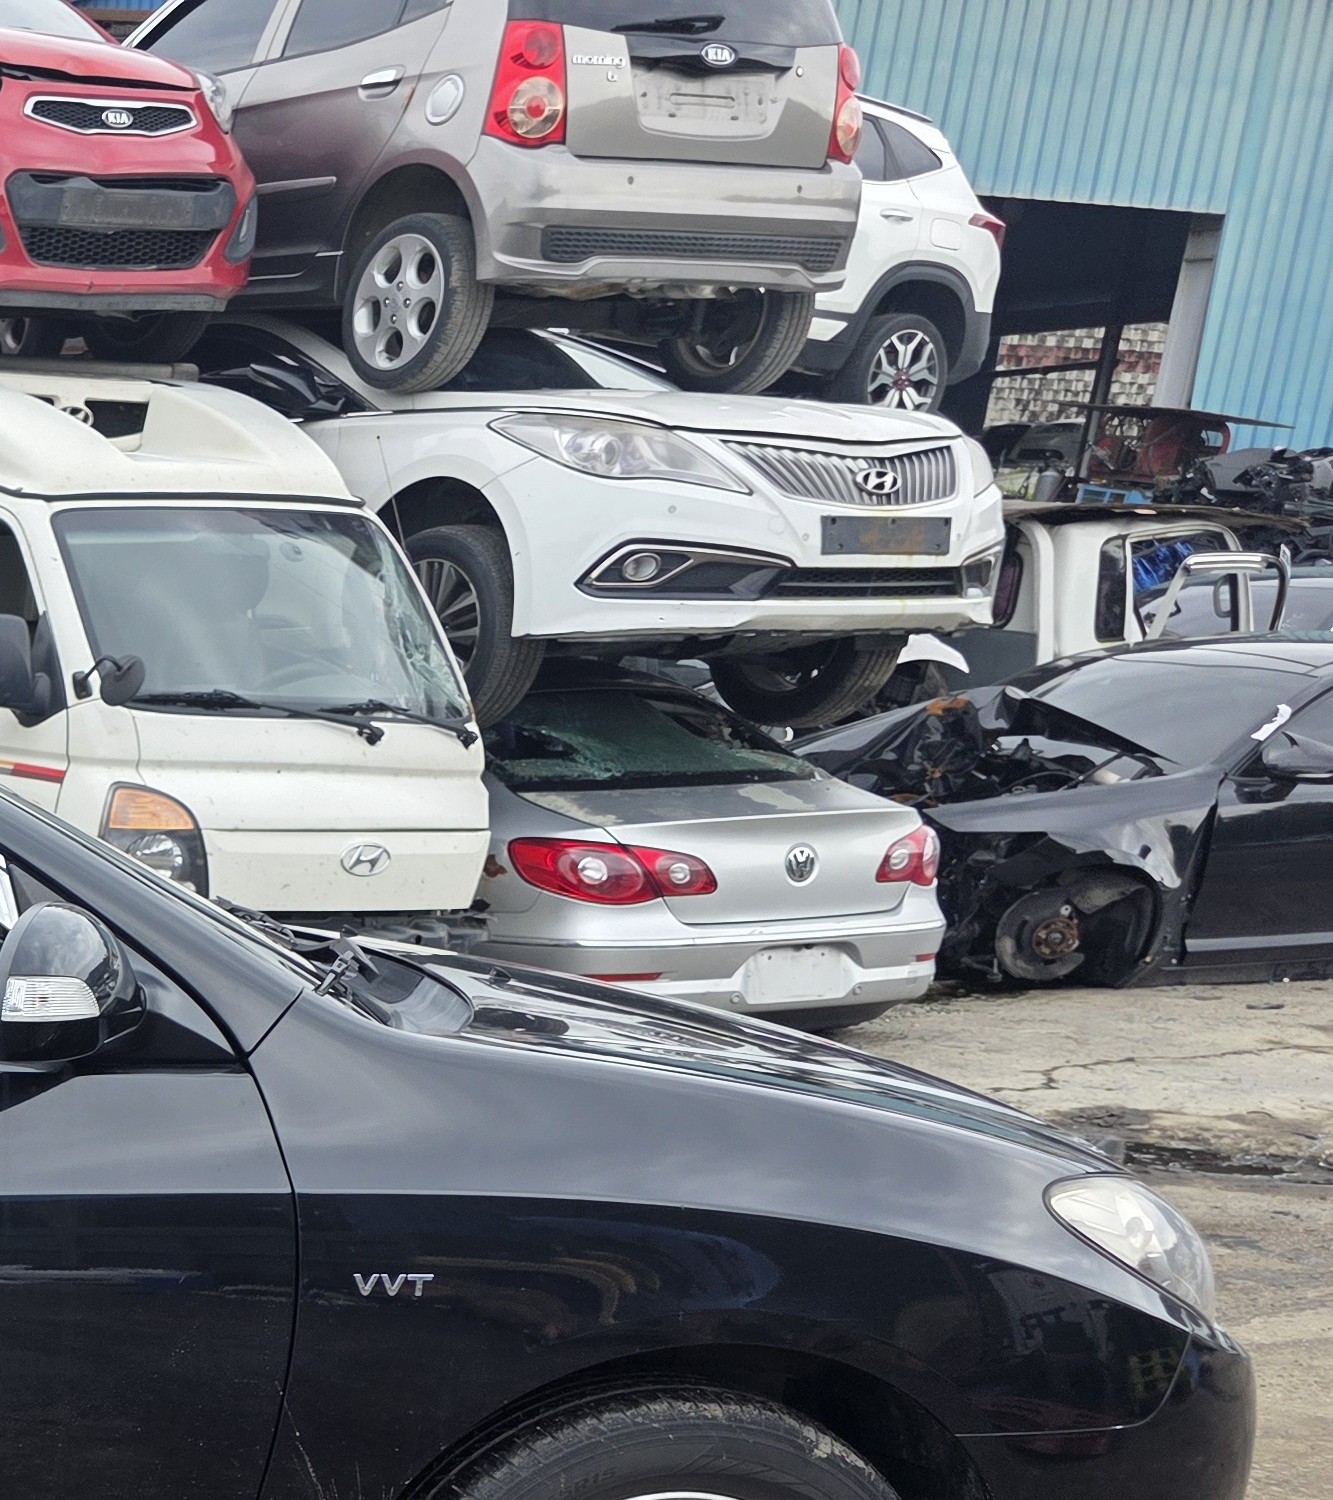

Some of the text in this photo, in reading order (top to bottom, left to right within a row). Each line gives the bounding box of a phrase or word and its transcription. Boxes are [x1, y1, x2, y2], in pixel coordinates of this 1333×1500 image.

[572, 54, 626, 68] morning
[705, 46, 732, 62] KIA
[106, 111, 130, 124] KIA
[353, 1273, 434, 1297] VVT
